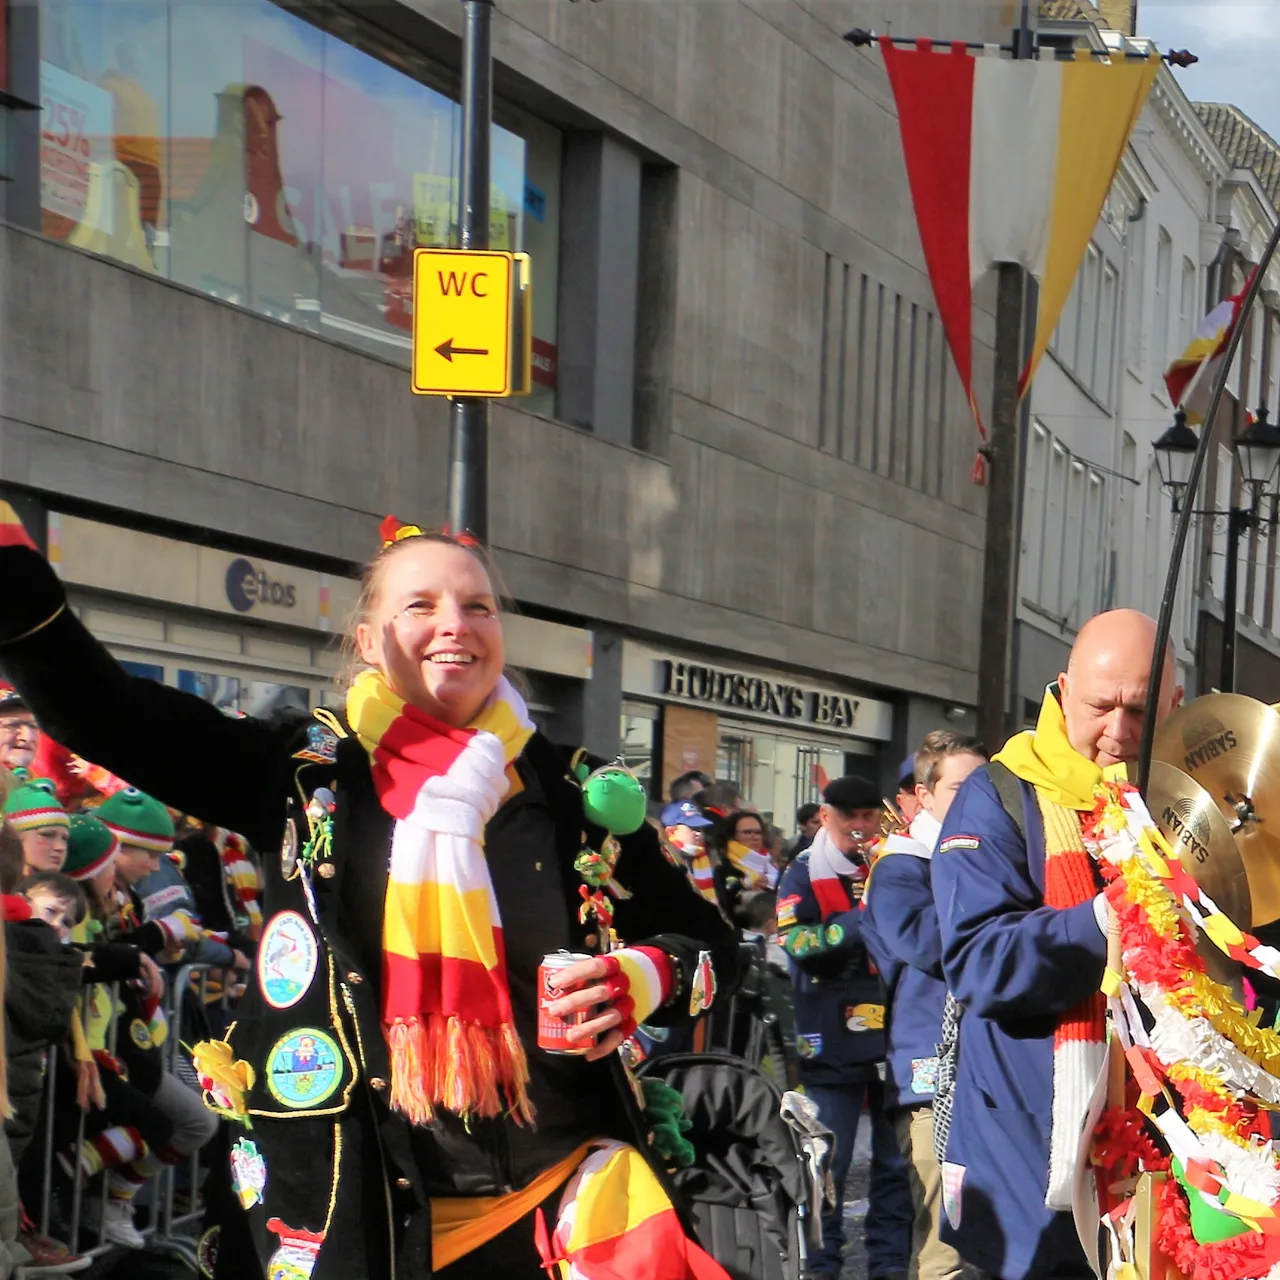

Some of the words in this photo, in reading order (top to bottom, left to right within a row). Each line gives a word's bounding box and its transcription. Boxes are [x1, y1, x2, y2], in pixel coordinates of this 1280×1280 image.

[438, 271, 488, 297] WC
[242, 571, 296, 607] etos
[666, 660, 804, 719] HUDSON'S
[814, 692, 860, 727] BAY
[1184, 730, 1237, 772] SABIAN
[1161, 806, 1209, 864] SABIAN
